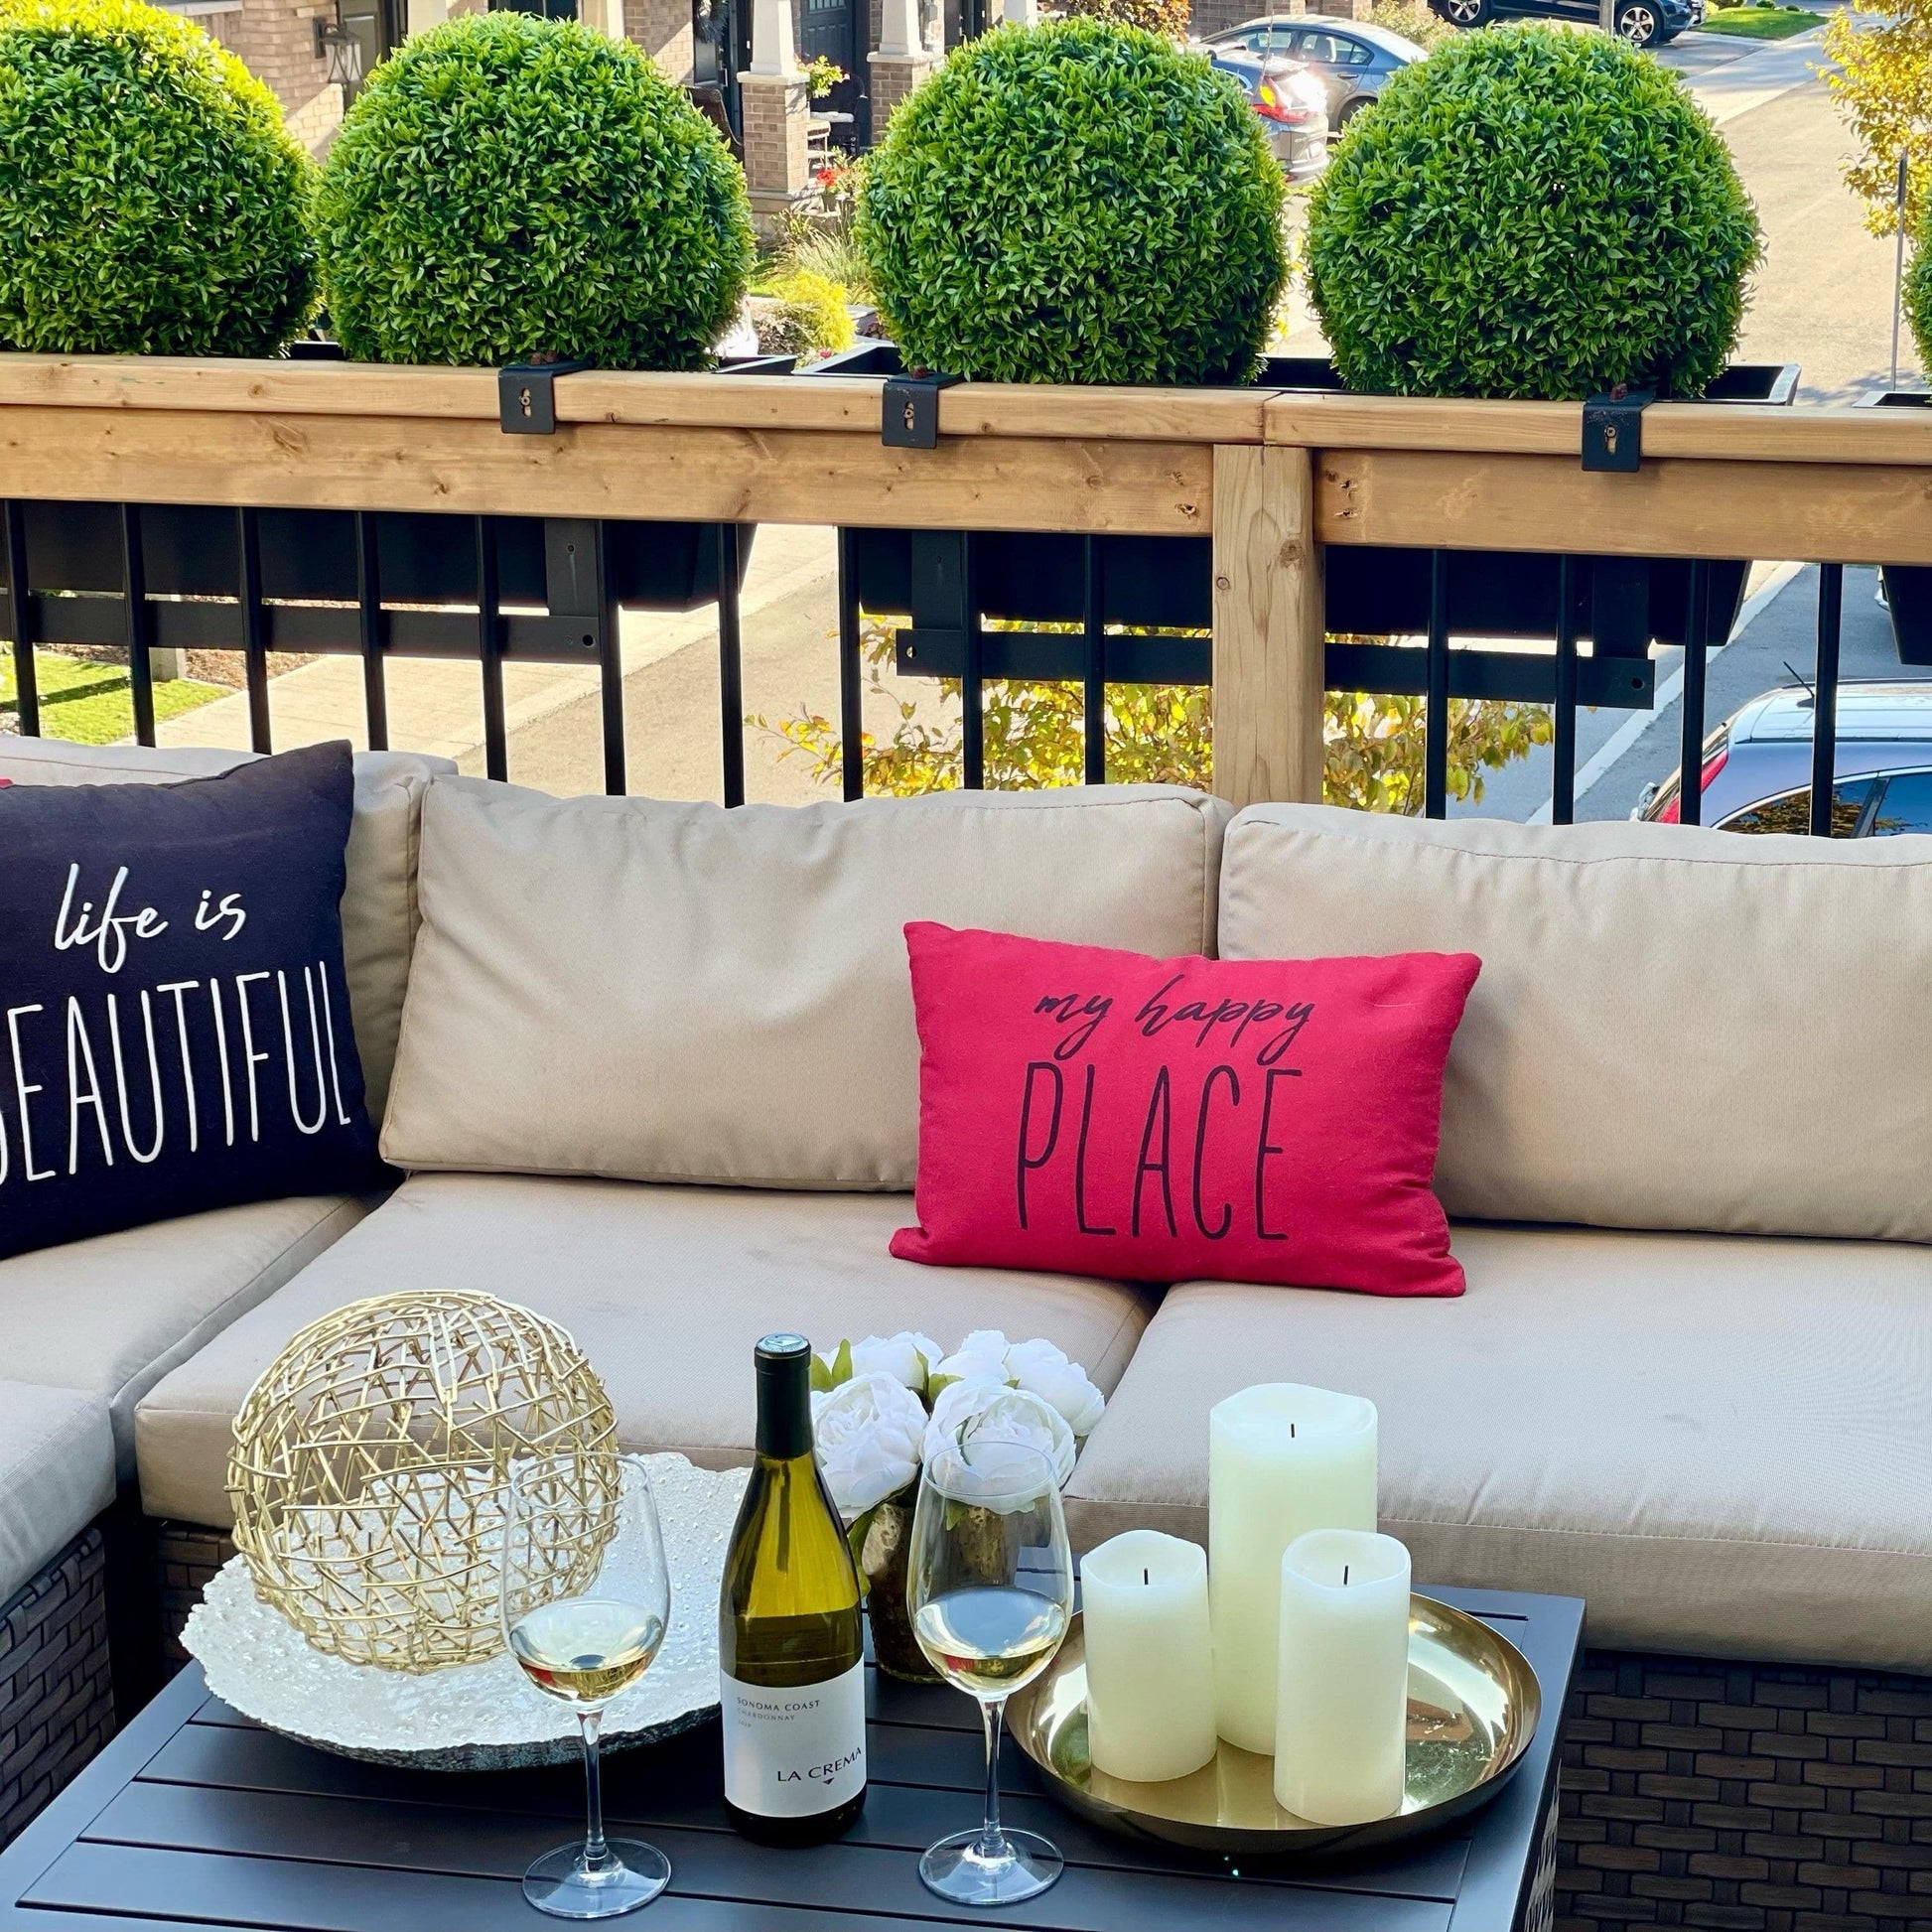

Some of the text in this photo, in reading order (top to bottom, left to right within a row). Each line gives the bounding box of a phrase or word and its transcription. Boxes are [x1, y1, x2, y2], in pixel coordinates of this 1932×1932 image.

[55, 863, 246, 974] life is
[1034, 973, 1315, 1066] my happy
[0, 960, 351, 1185] EAUTIFUL
[1017, 1061, 1303, 1241] PLACE
[737, 1697, 820, 1712] SONOMA COAST
[777, 1746, 862, 1782] LA CREMA
